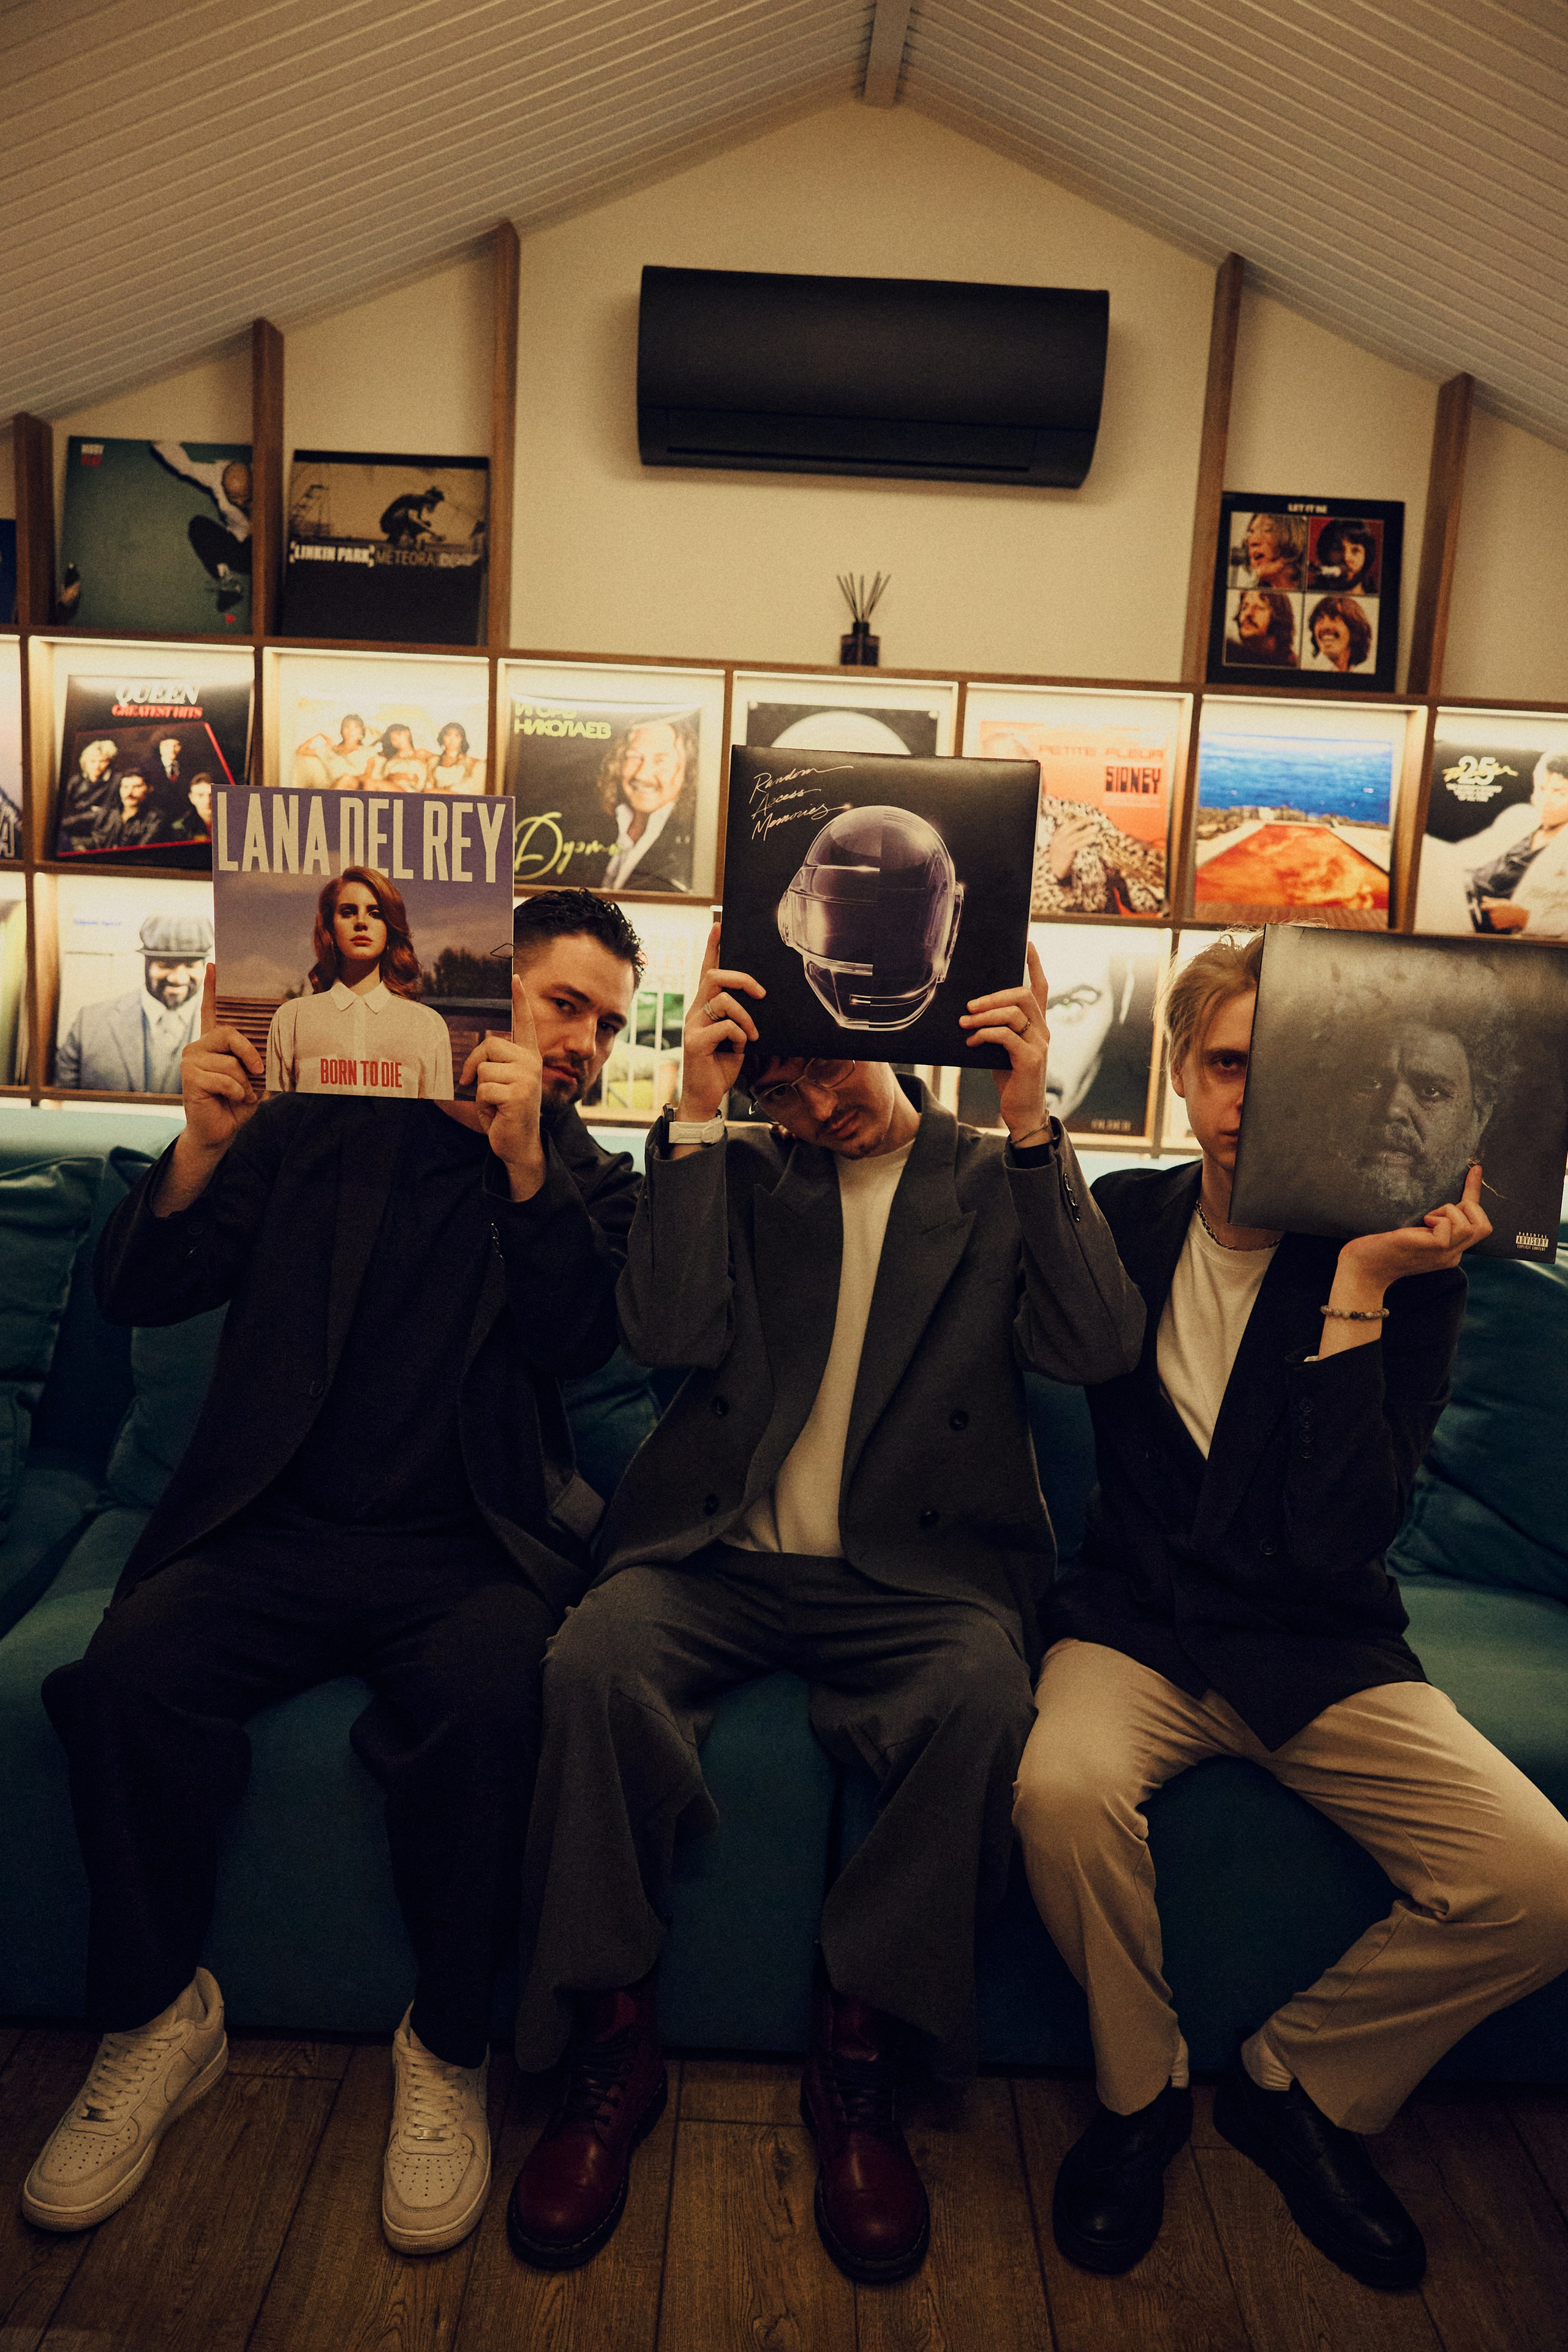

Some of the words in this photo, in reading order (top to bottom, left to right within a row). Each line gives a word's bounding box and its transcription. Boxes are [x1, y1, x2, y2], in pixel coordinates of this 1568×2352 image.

[115, 682, 200, 707] QUEEN
[111, 704, 173, 718] GREATEST
[172, 705, 203, 719] HITS
[514, 718, 612, 739] НИКОЛАЕВ
[749, 765, 854, 804] Random
[1105, 766, 1161, 793] SIDNEY
[1458, 755, 1496, 786] 25
[751, 788, 822, 820] Access
[217, 791, 331, 875] LANA
[339, 796, 414, 880] DEL
[423, 800, 506, 883] REY
[752, 803, 852, 841] Memories
[320, 1058, 357, 1085] BORN
[360, 1060, 379, 1087] TO
[381, 1061, 402, 1088] DIE
[1517, 1237, 1547, 1246] ADVISORY
